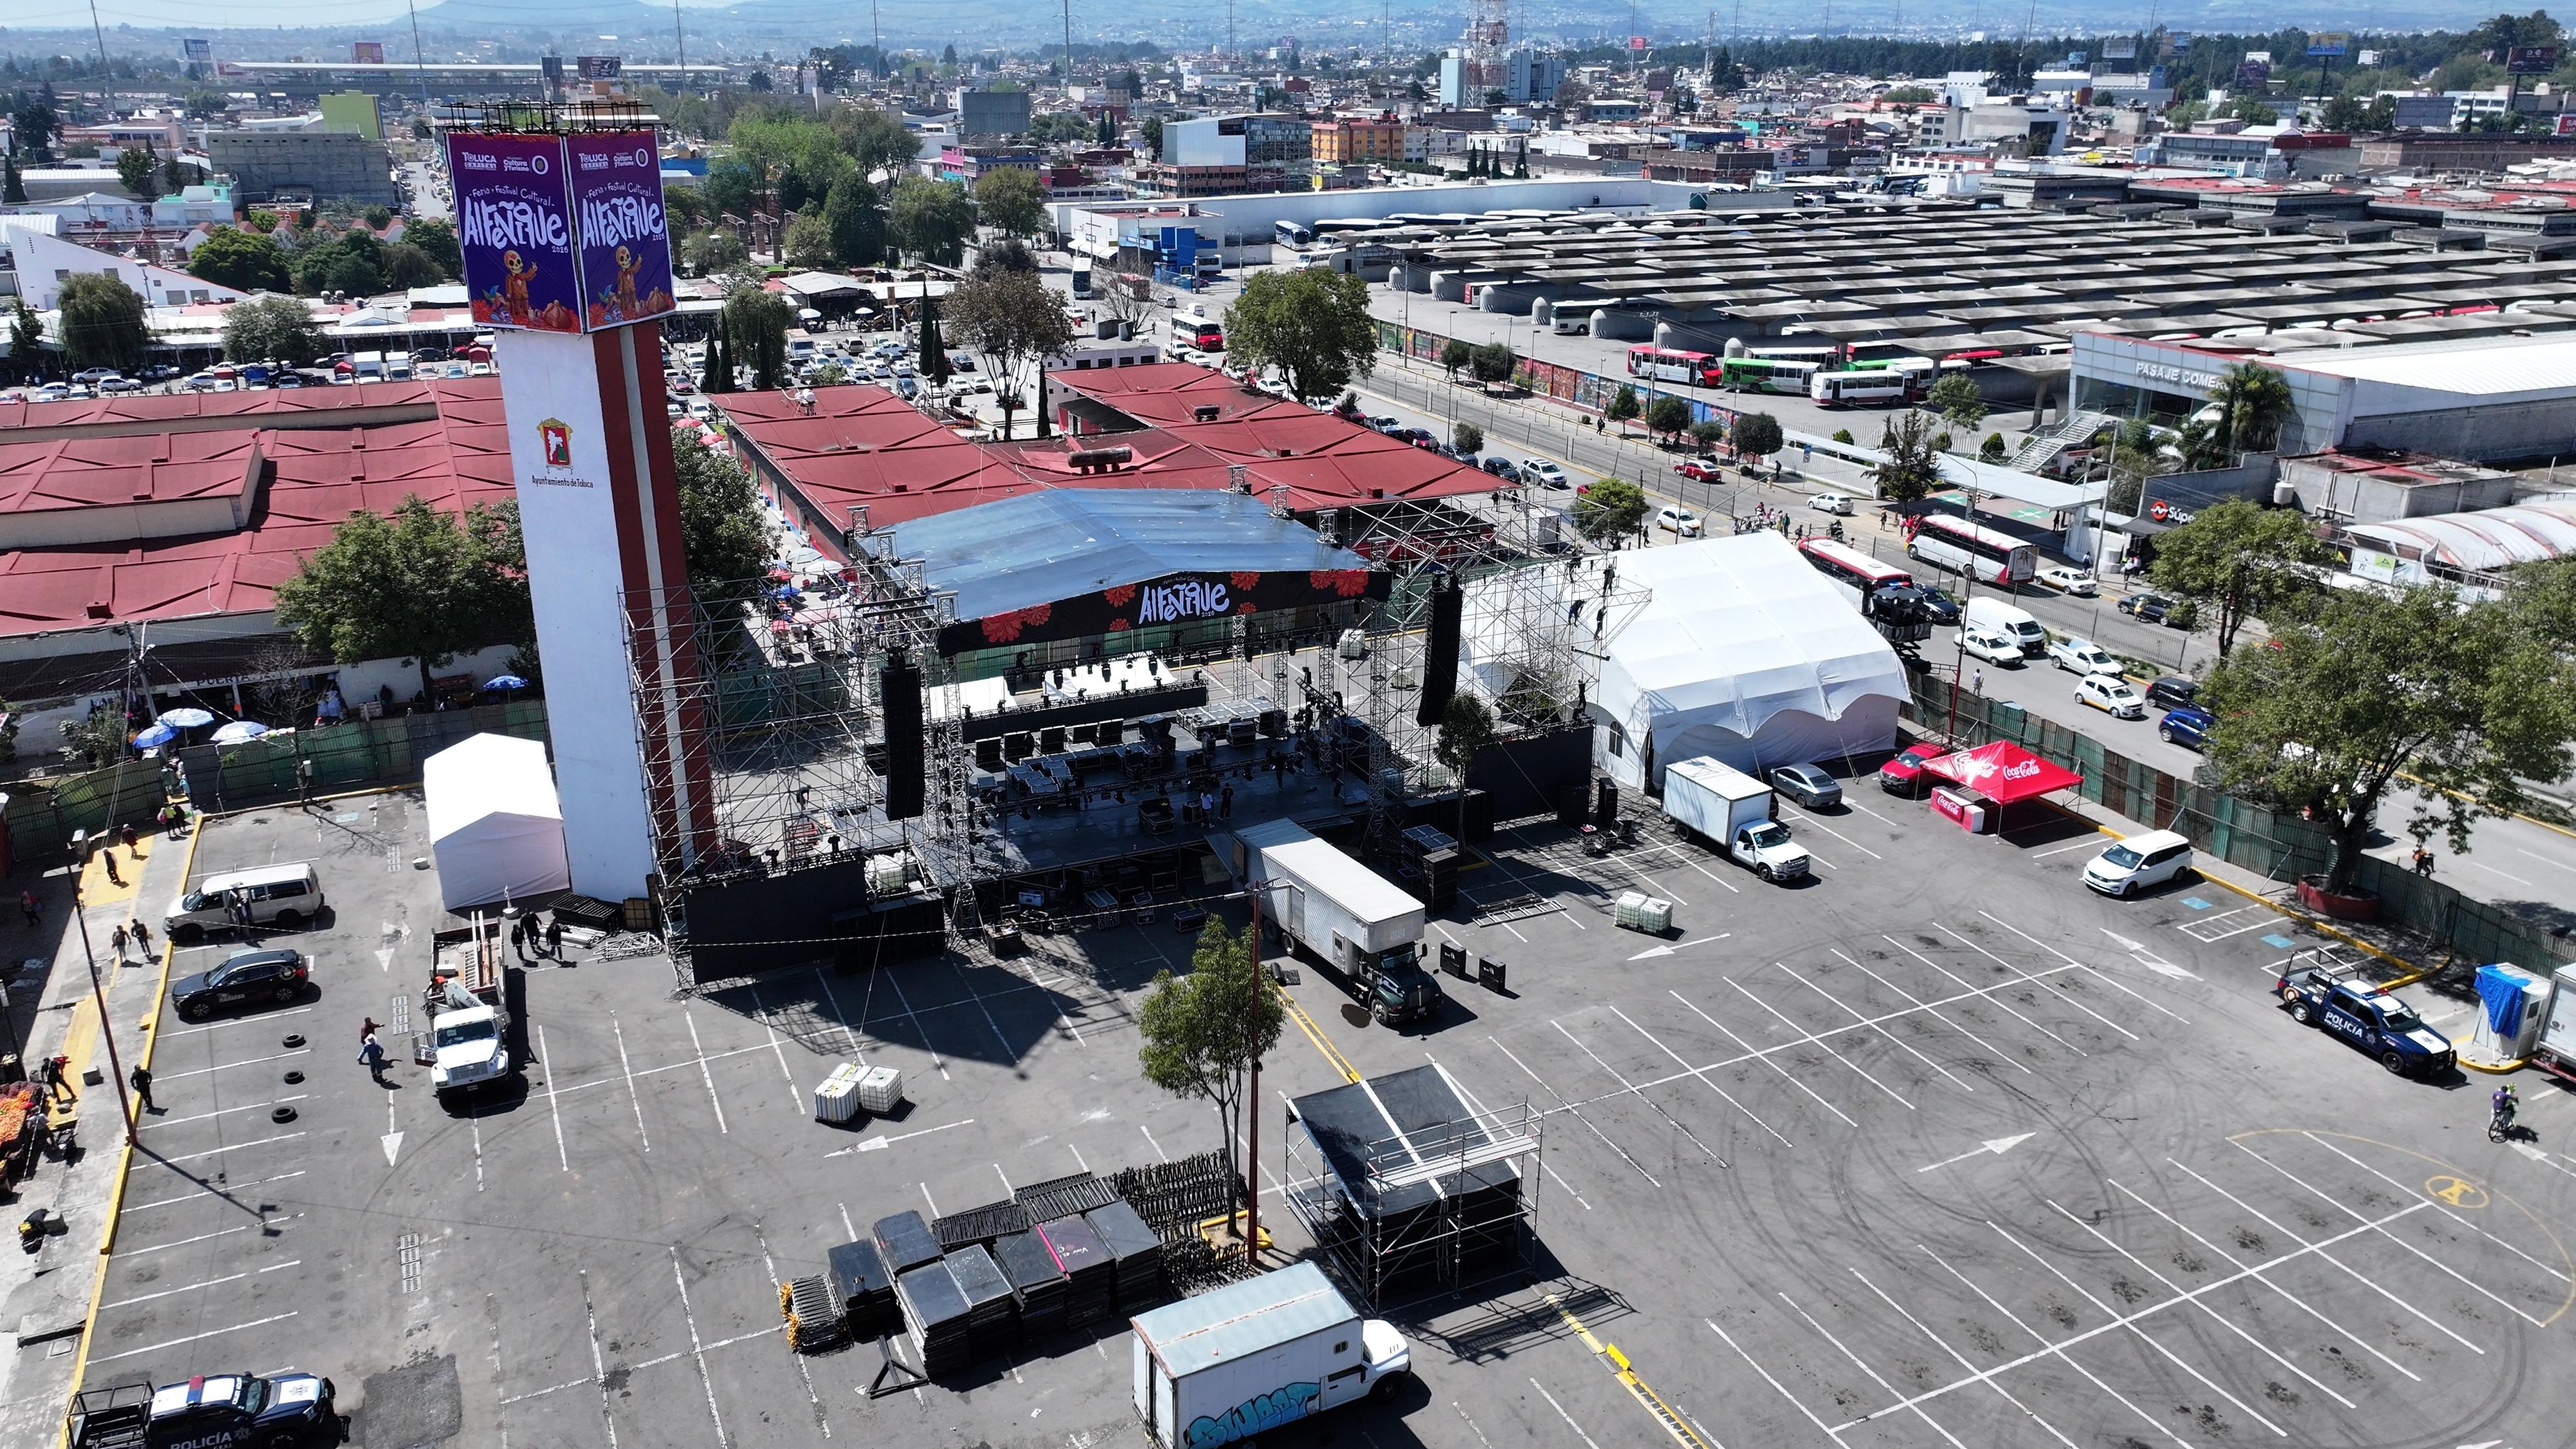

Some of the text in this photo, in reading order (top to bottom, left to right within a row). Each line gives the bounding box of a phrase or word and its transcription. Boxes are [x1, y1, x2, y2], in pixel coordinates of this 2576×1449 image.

[461, 152, 497, 163] TOLUCA
[578, 153, 608, 163] TOLUCA
[495, 185, 518, 196] Festival
[607, 181, 626, 192] Festival
[2136, 362, 2181, 382] PASAJE
[532, 474, 594, 488] Ayuntamiento de Toluca
[2003, 759, 2040, 780] Coca-Cola
[1938, 796, 1959, 816] Coca-Cola
[2325, 1011, 2364, 1038] POLICÍA
